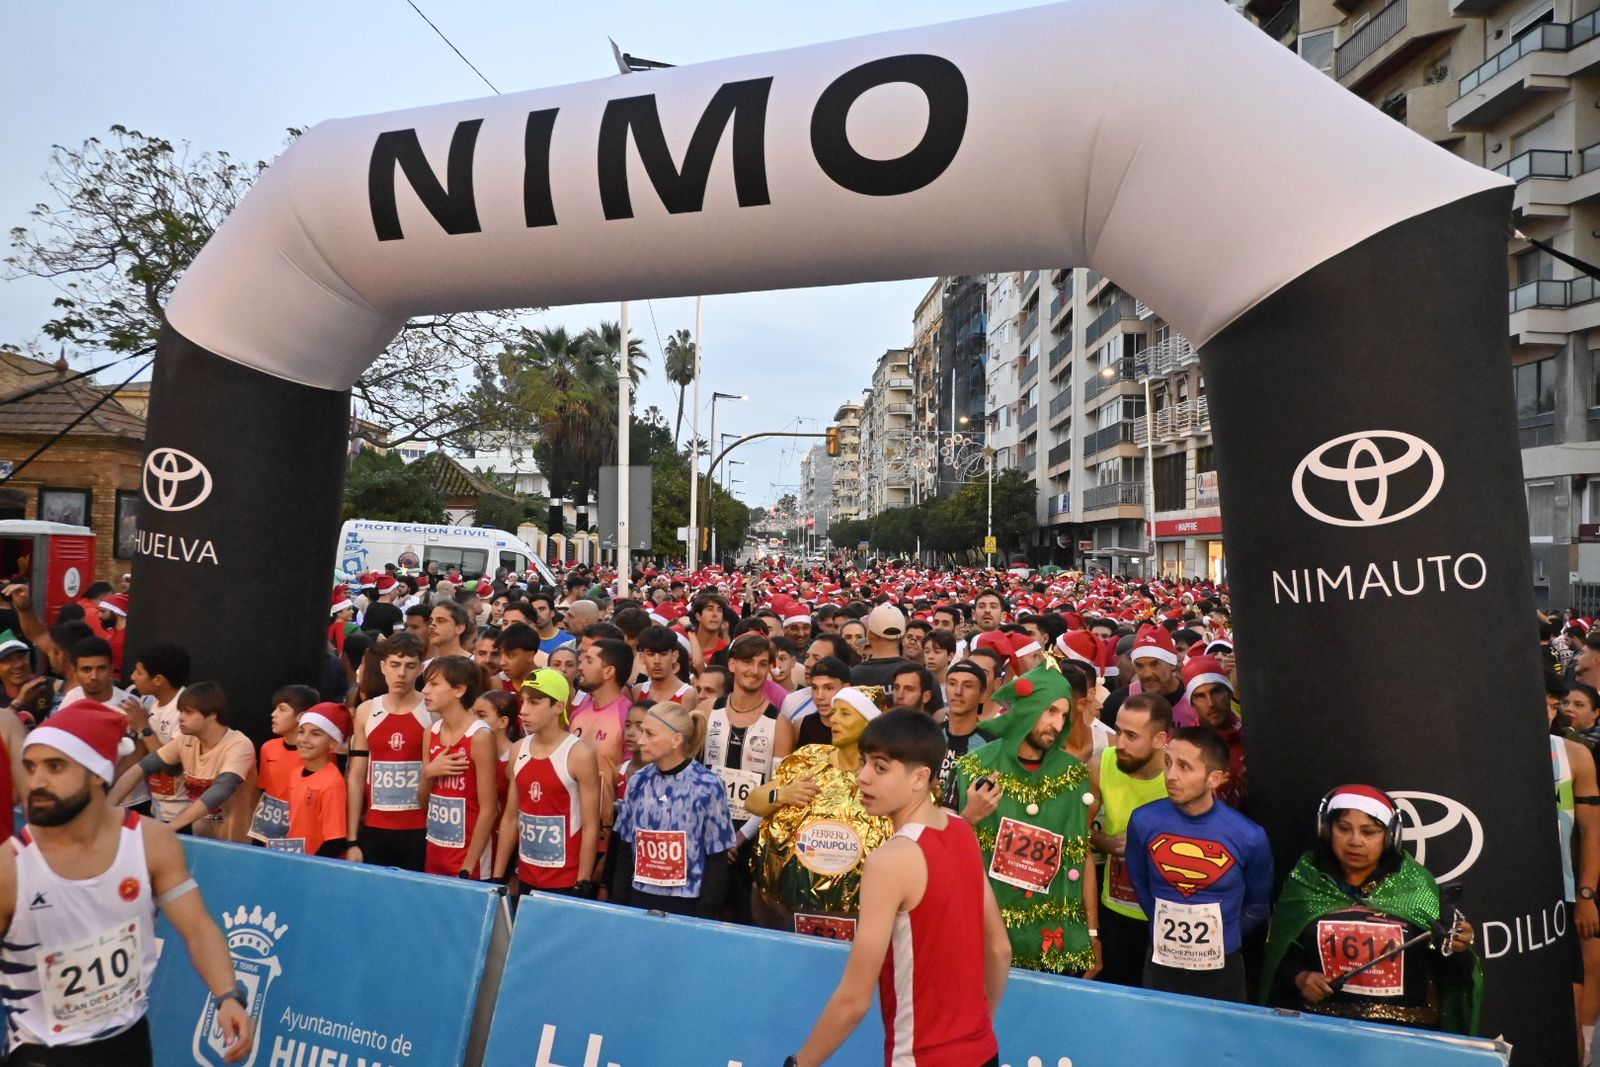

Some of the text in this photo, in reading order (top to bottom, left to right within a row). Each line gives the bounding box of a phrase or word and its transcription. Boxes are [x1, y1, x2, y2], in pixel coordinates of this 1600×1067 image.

[368, 53, 969, 242] NIMO
[354, 523, 490, 538] PROTECCION CIVIL
[1178, 521, 1198, 532] MAPFRE
[134, 529, 219, 565] HUELVA
[1272, 552, 1487, 604] NIMAUTO
[374, 769, 419, 788] 2652
[427, 803, 461, 825] 2590
[519, 821, 561, 844] 2573
[811, 828, 850, 840] FERRERO
[638, 840, 682, 861] 1080
[811, 839, 858, 852] ONUPOLIS
[1003, 832, 1058, 867] 1282
[1163, 918, 1210, 945] 232
[1482, 899, 1567, 959] DILLO
[60, 948, 129, 997] 210
[280, 1006, 413, 1057] Ayuntamiento de
